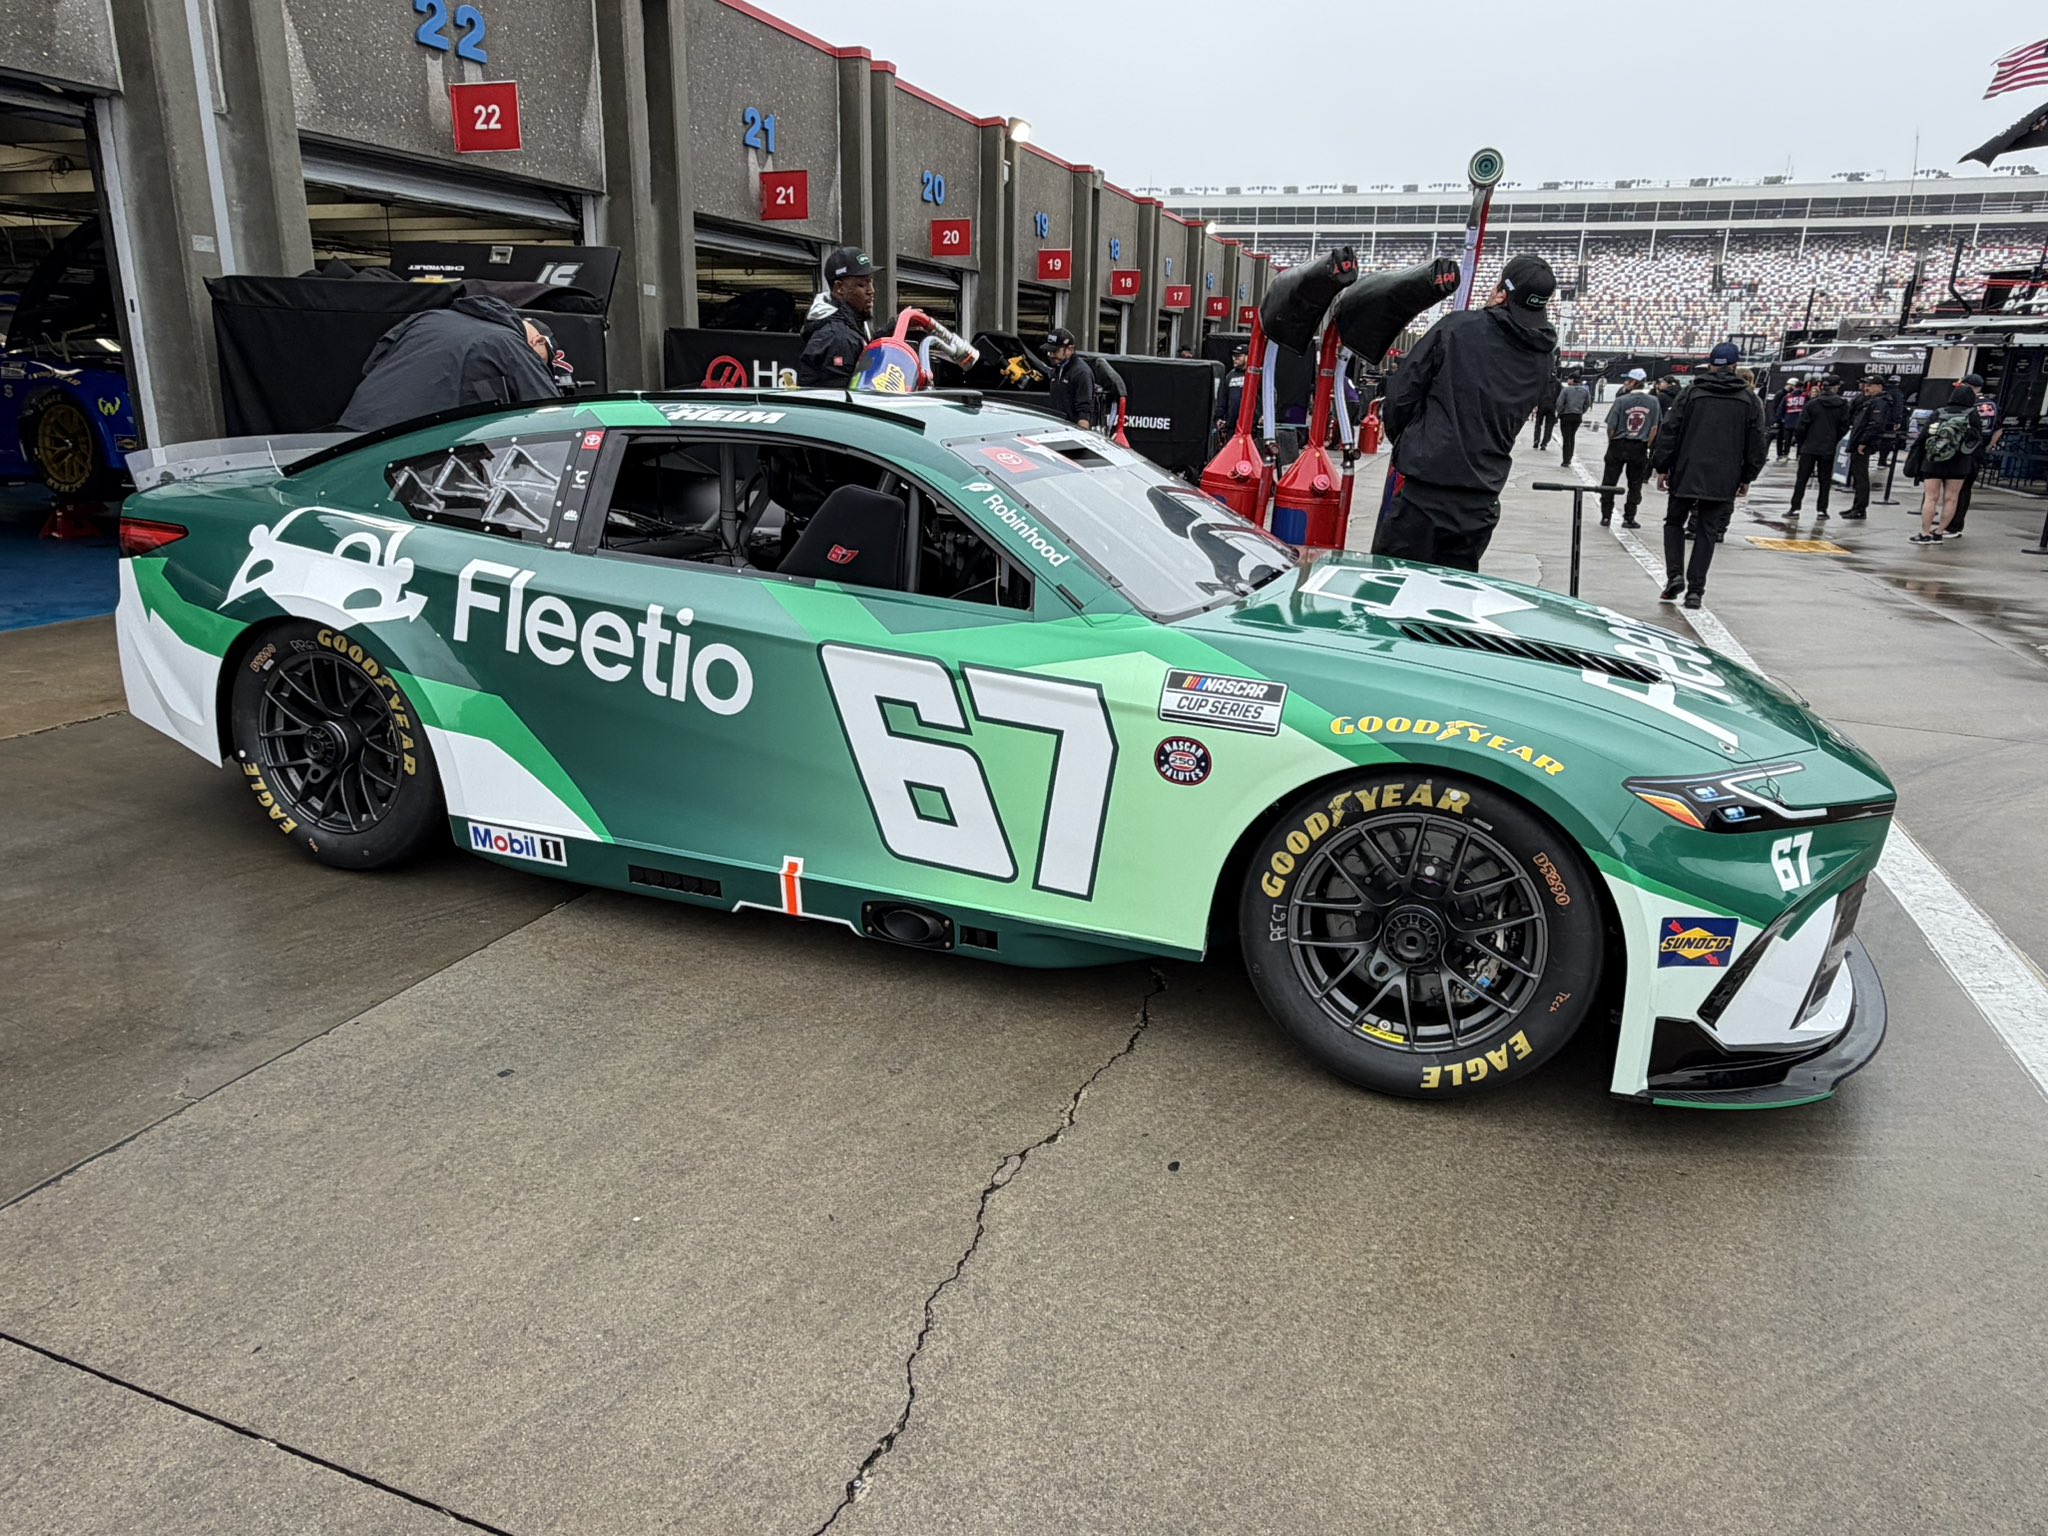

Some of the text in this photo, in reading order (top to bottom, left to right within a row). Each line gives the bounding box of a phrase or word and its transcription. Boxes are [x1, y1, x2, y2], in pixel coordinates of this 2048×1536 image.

[412, 0, 488, 64] 22
[473, 104, 502, 130] 22
[743, 106, 776, 154] 21
[775, 186, 795, 205] 21
[922, 169, 946, 206] 20
[942, 230, 960, 245] 20
[1034, 211, 1049, 239] 19
[1110, 237, 1121, 261] 18
[1047, 258, 1062, 271] 19
[1120, 277, 1132, 288] 18
[1173, 291, 1184, 301] 17
[1213, 302, 1223, 311] 16
[1245, 311, 1254, 320] 15
[1864, 363, 1896, 375] CREW
[667, 409, 787, 424] HEIM
[982, 493, 1070, 567] Robinhood
[453, 558, 754, 716] Fleetio
[1202, 677, 1269, 699] NASCAR
[317, 628, 417, 776] GOODYEAR
[1176, 696, 1264, 720] CUP SERIES
[1163, 740, 1205, 758] NASCAR
[1330, 715, 1566, 776] GOODYEAR
[816, 638, 1120, 903] 67
[1160, 763, 1203, 782] SALUTES
[1169, 755, 1197, 767] 250
[243, 762, 298, 834] EAGLE
[472, 826, 538, 858] Mobil
[1261, 783, 1472, 898] GOODYEAR
[1770, 831, 1814, 892] 67
[1532, 852, 1571, 906] D5290
[1269, 903, 1288, 943] RF67
[1662, 936, 1731, 951] SUNOCO
[1420, 1029, 1533, 1089] EAGLE
